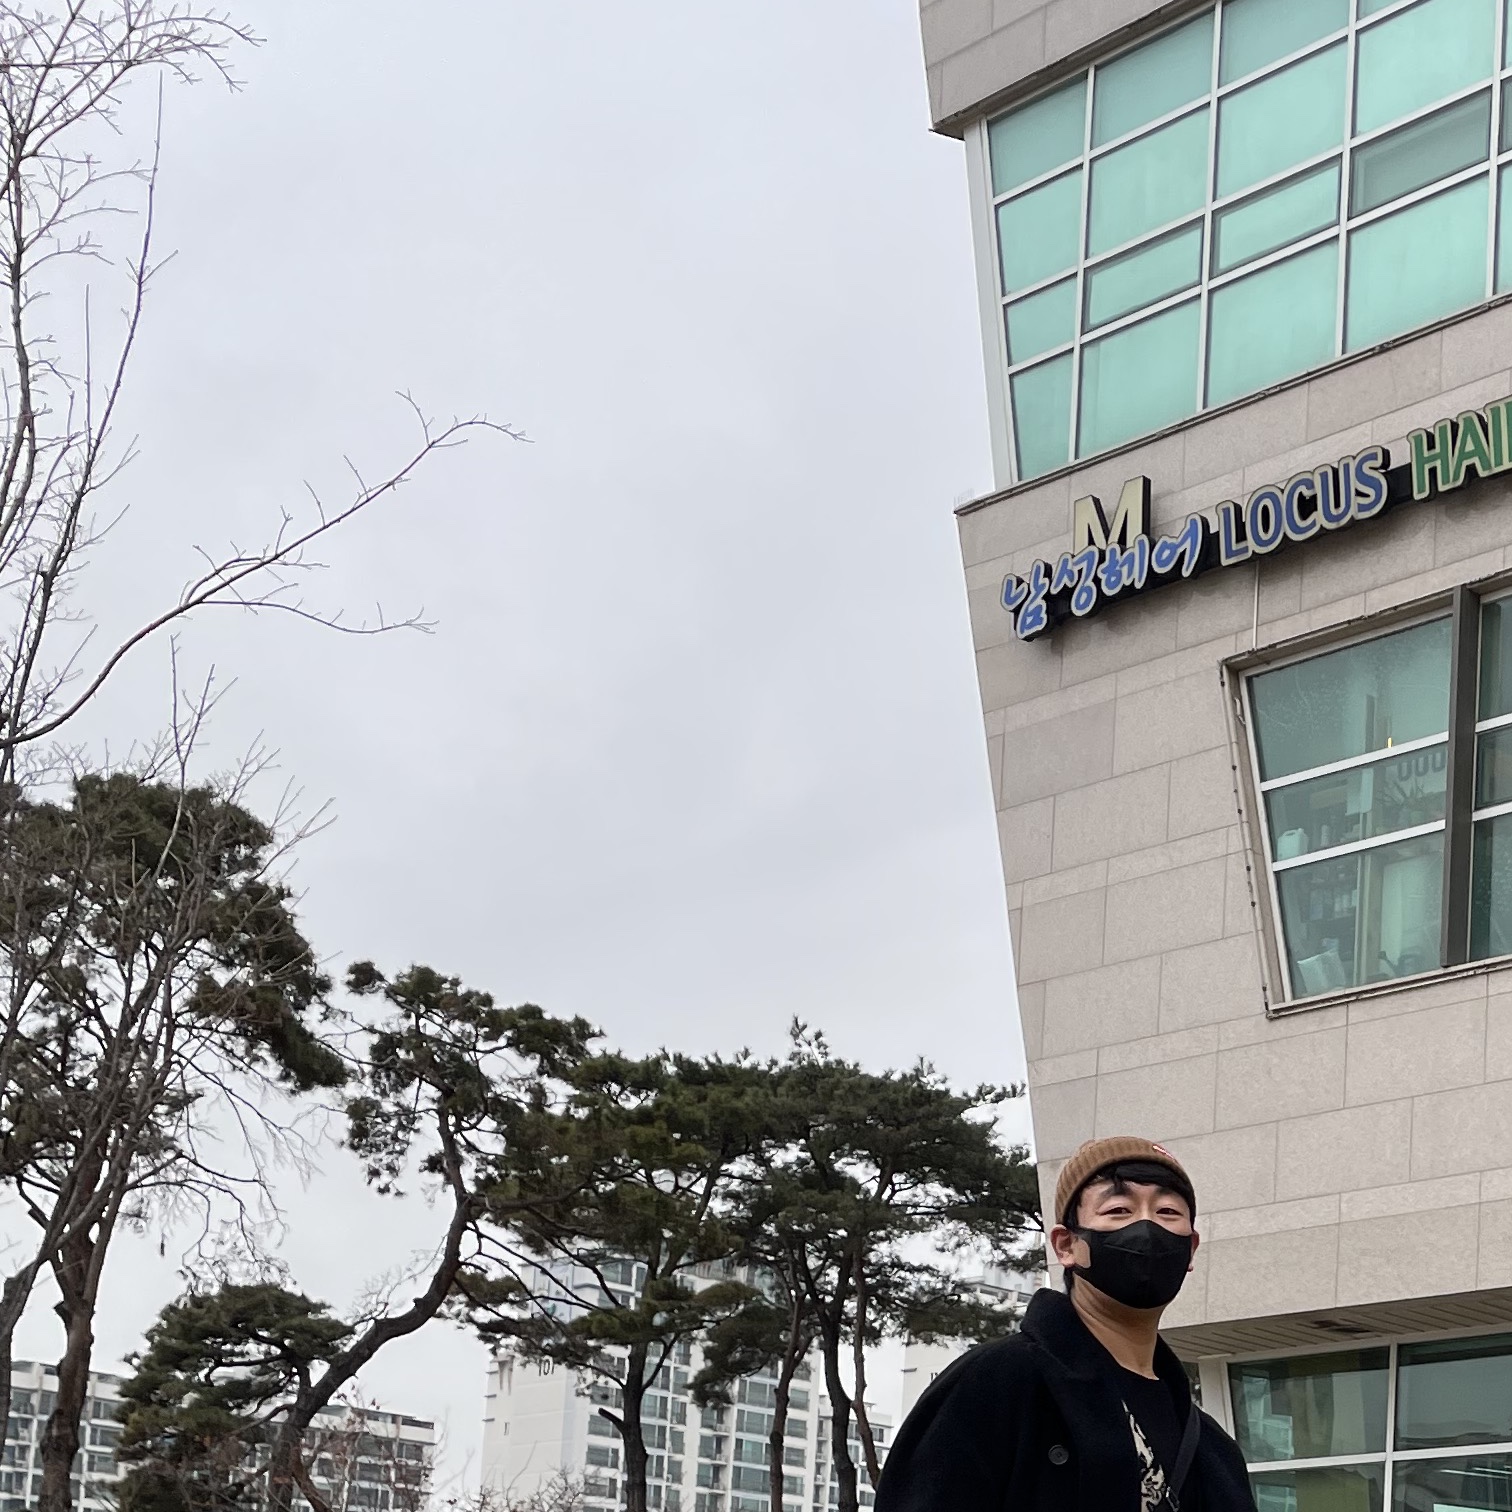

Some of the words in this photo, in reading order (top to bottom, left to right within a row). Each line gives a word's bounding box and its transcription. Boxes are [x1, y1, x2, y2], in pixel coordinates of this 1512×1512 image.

[1001, 513, 1203, 639] 남성헤어
[1216, 445, 1389, 566] LOCUS
[1073, 476, 1143, 554] M
